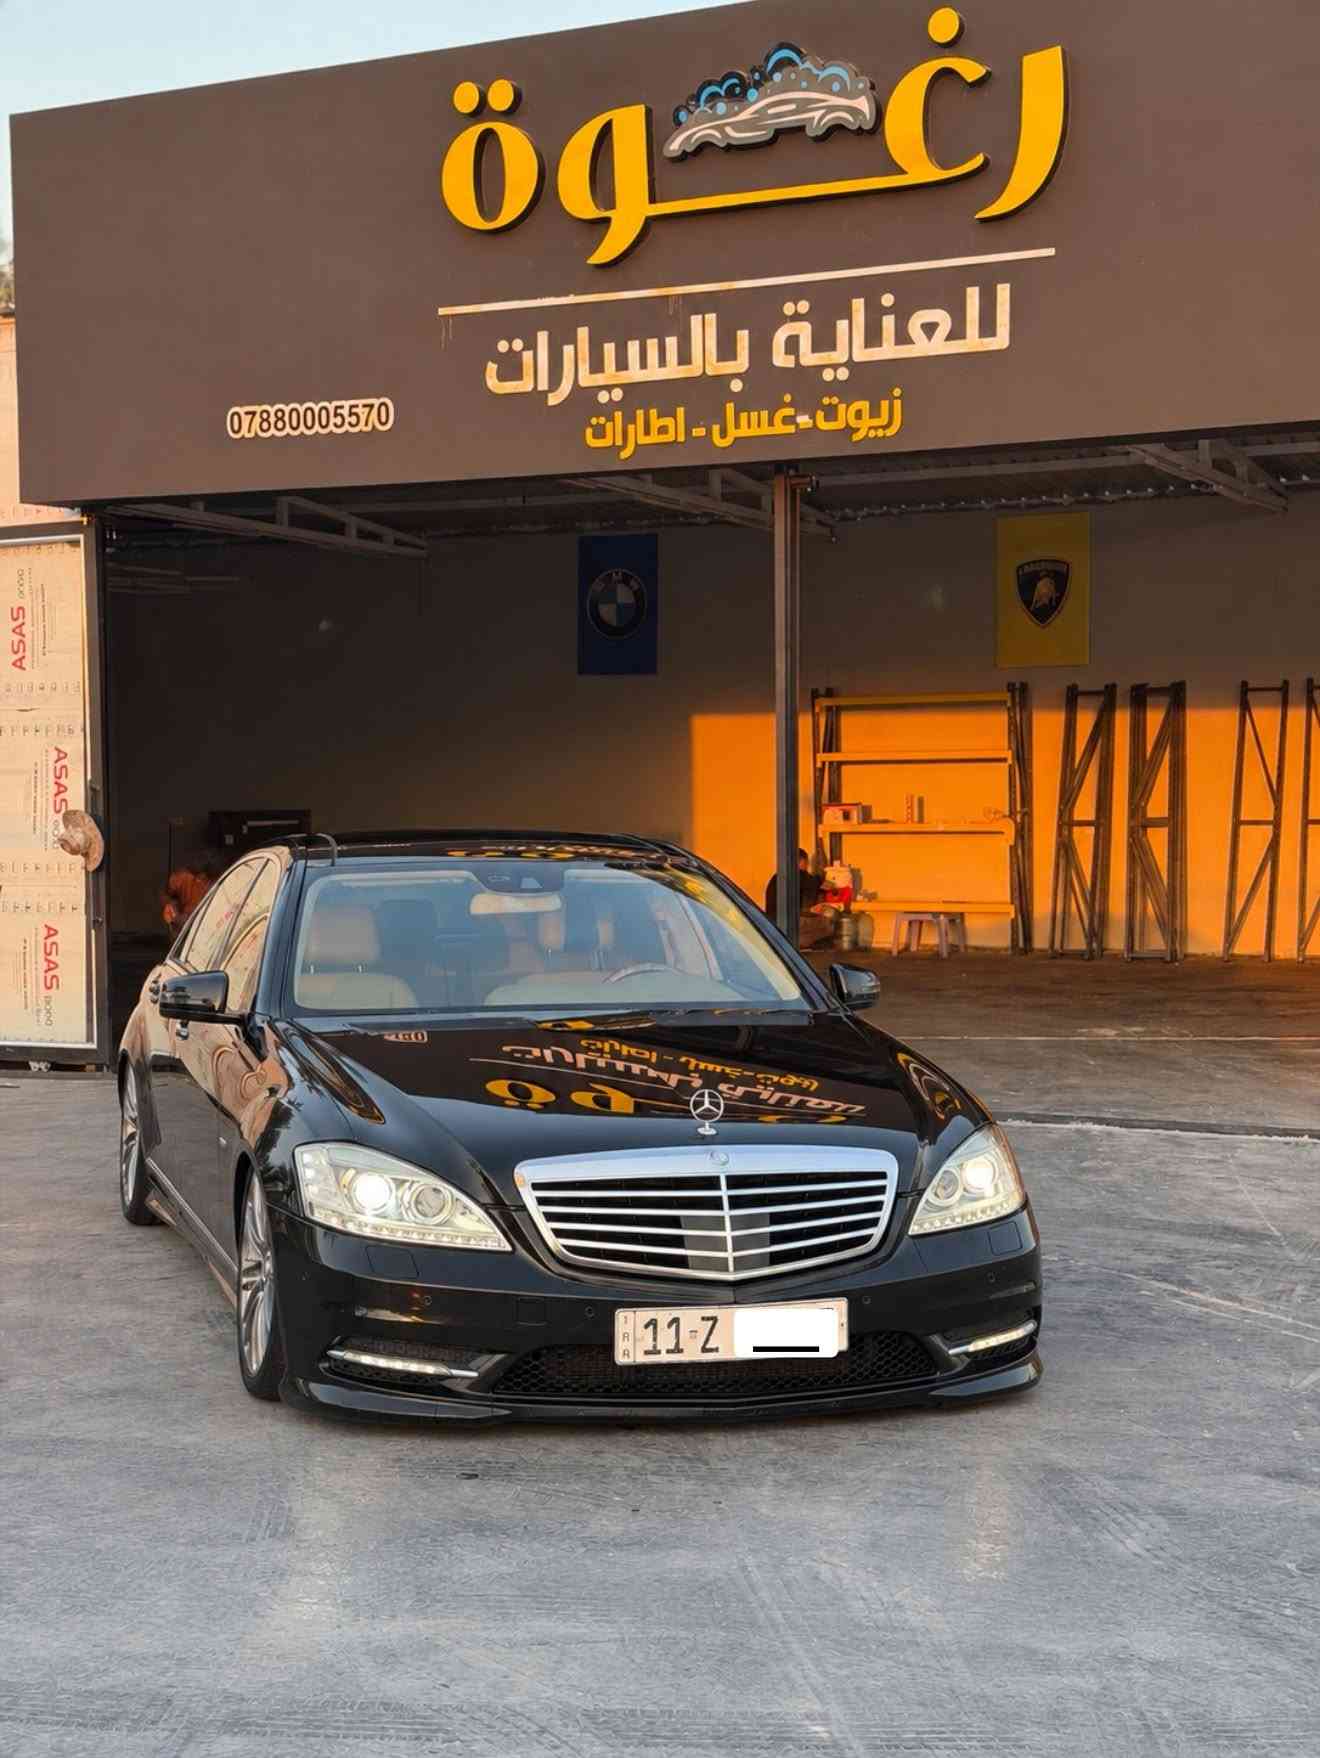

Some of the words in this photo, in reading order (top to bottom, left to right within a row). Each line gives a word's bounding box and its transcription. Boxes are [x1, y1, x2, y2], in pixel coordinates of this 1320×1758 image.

[441, 7, 1066, 265] رغوة
[485, 313, 749, 406] بالسيارات
[773, 283, 1010, 382] للعناية
[227, 398, 393, 438] 07880005570
[585, 407, 686, 460] اطارات
[11, 605, 26, 671] ASAS
[53, 746, 68, 814] ASAS
[43, 924, 59, 991] ASAS
